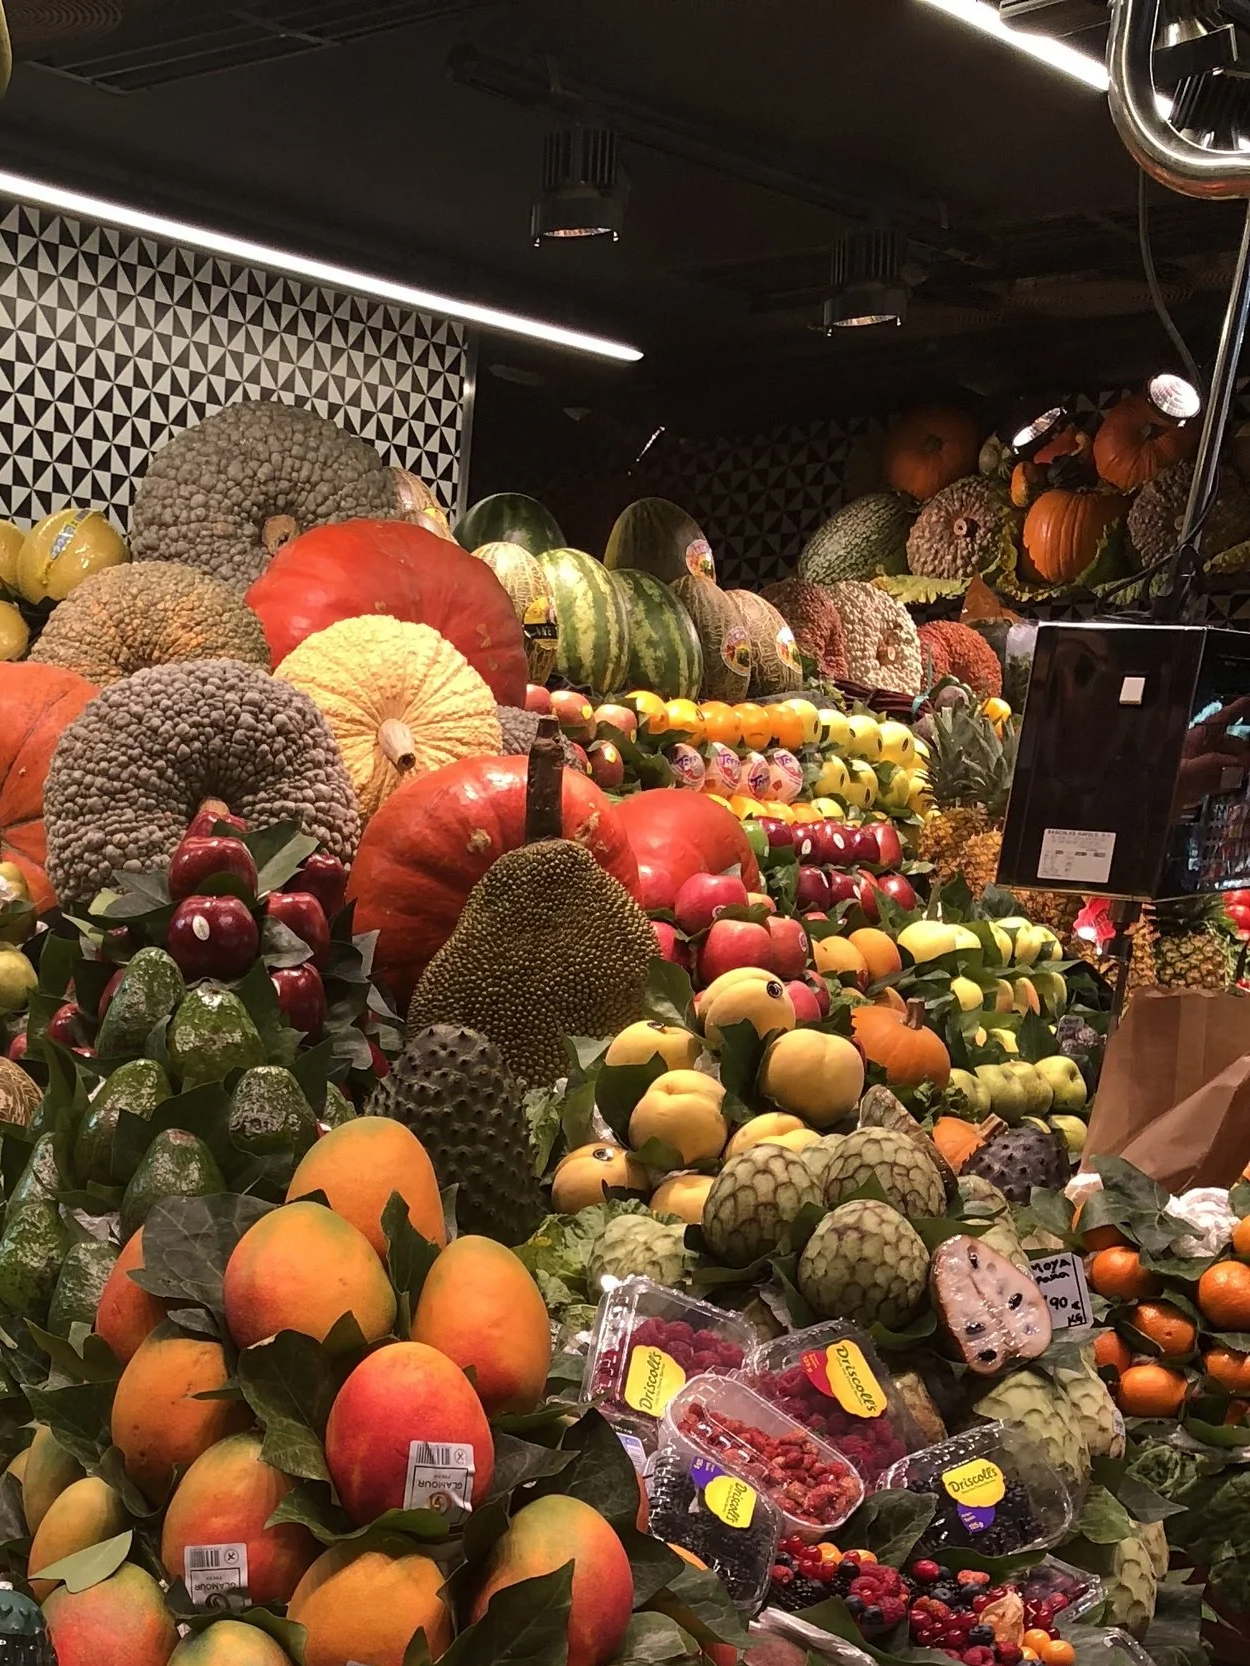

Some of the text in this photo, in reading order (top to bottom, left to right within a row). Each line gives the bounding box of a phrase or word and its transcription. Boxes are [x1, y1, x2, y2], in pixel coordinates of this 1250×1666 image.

[1031, 1258, 1071, 1274] MOYA
[639, 1351, 663, 1411] Driscoll's
[836, 1345, 878, 1412] Driscoll's
[947, 1466, 999, 1493] Driscoll's
[726, 1481, 749, 1523] Driscoll's
